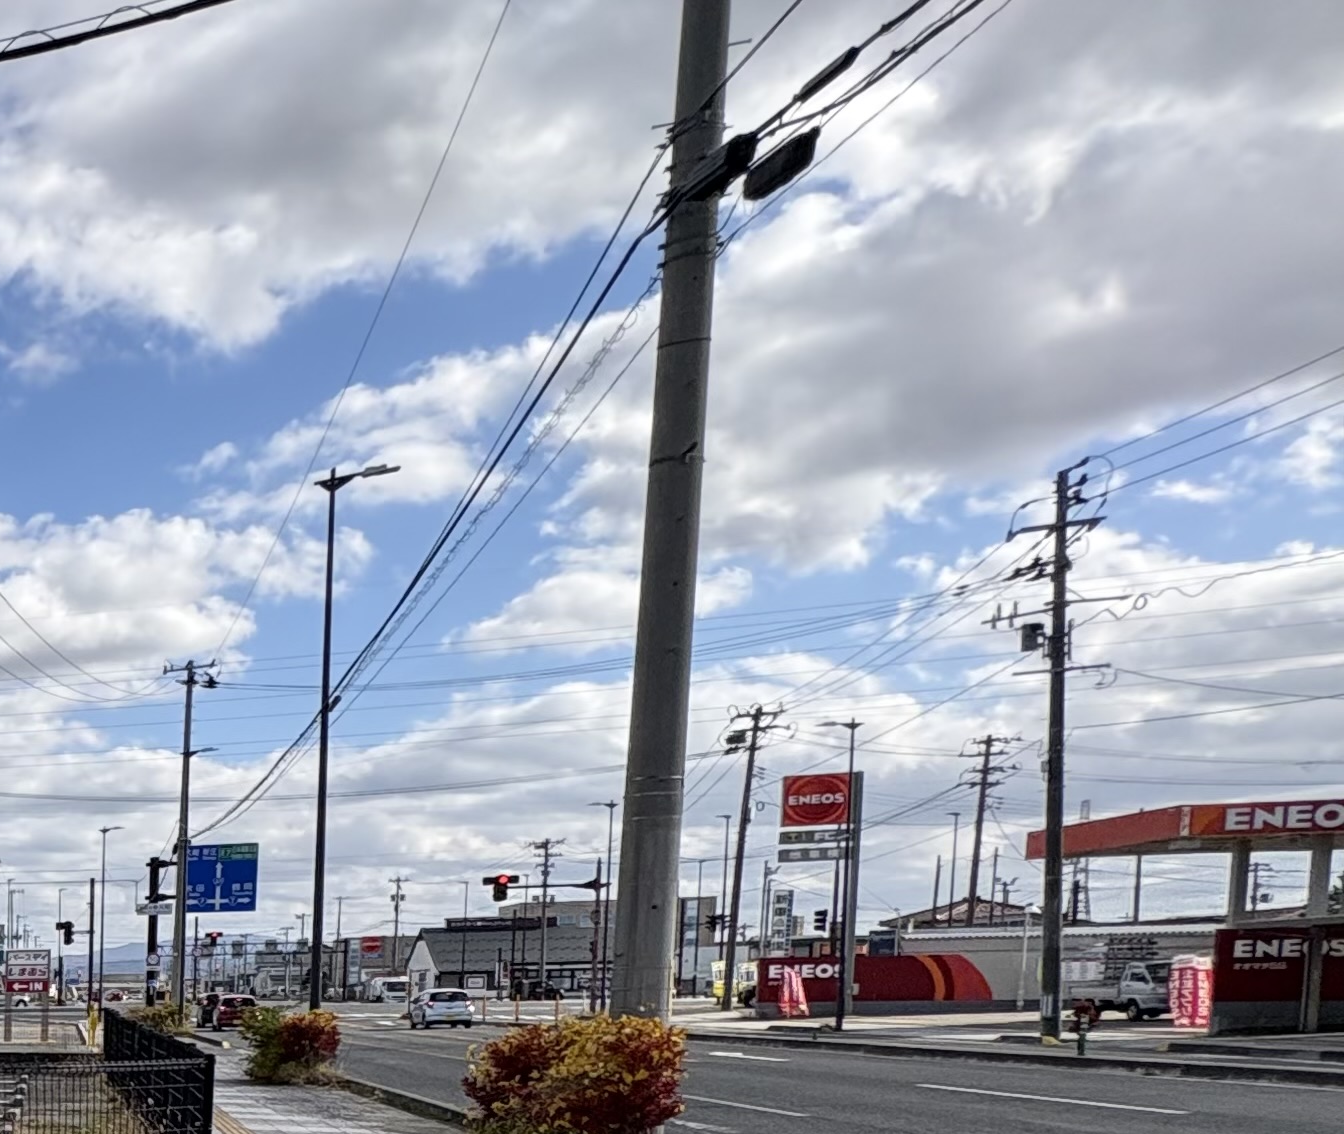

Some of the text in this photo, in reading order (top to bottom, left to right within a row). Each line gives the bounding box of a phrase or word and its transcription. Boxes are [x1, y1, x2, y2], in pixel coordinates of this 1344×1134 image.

[788, 793, 845, 805] ENEOS
[1225, 803, 1344, 831] ENEO
[29, 982, 43, 991] IN
